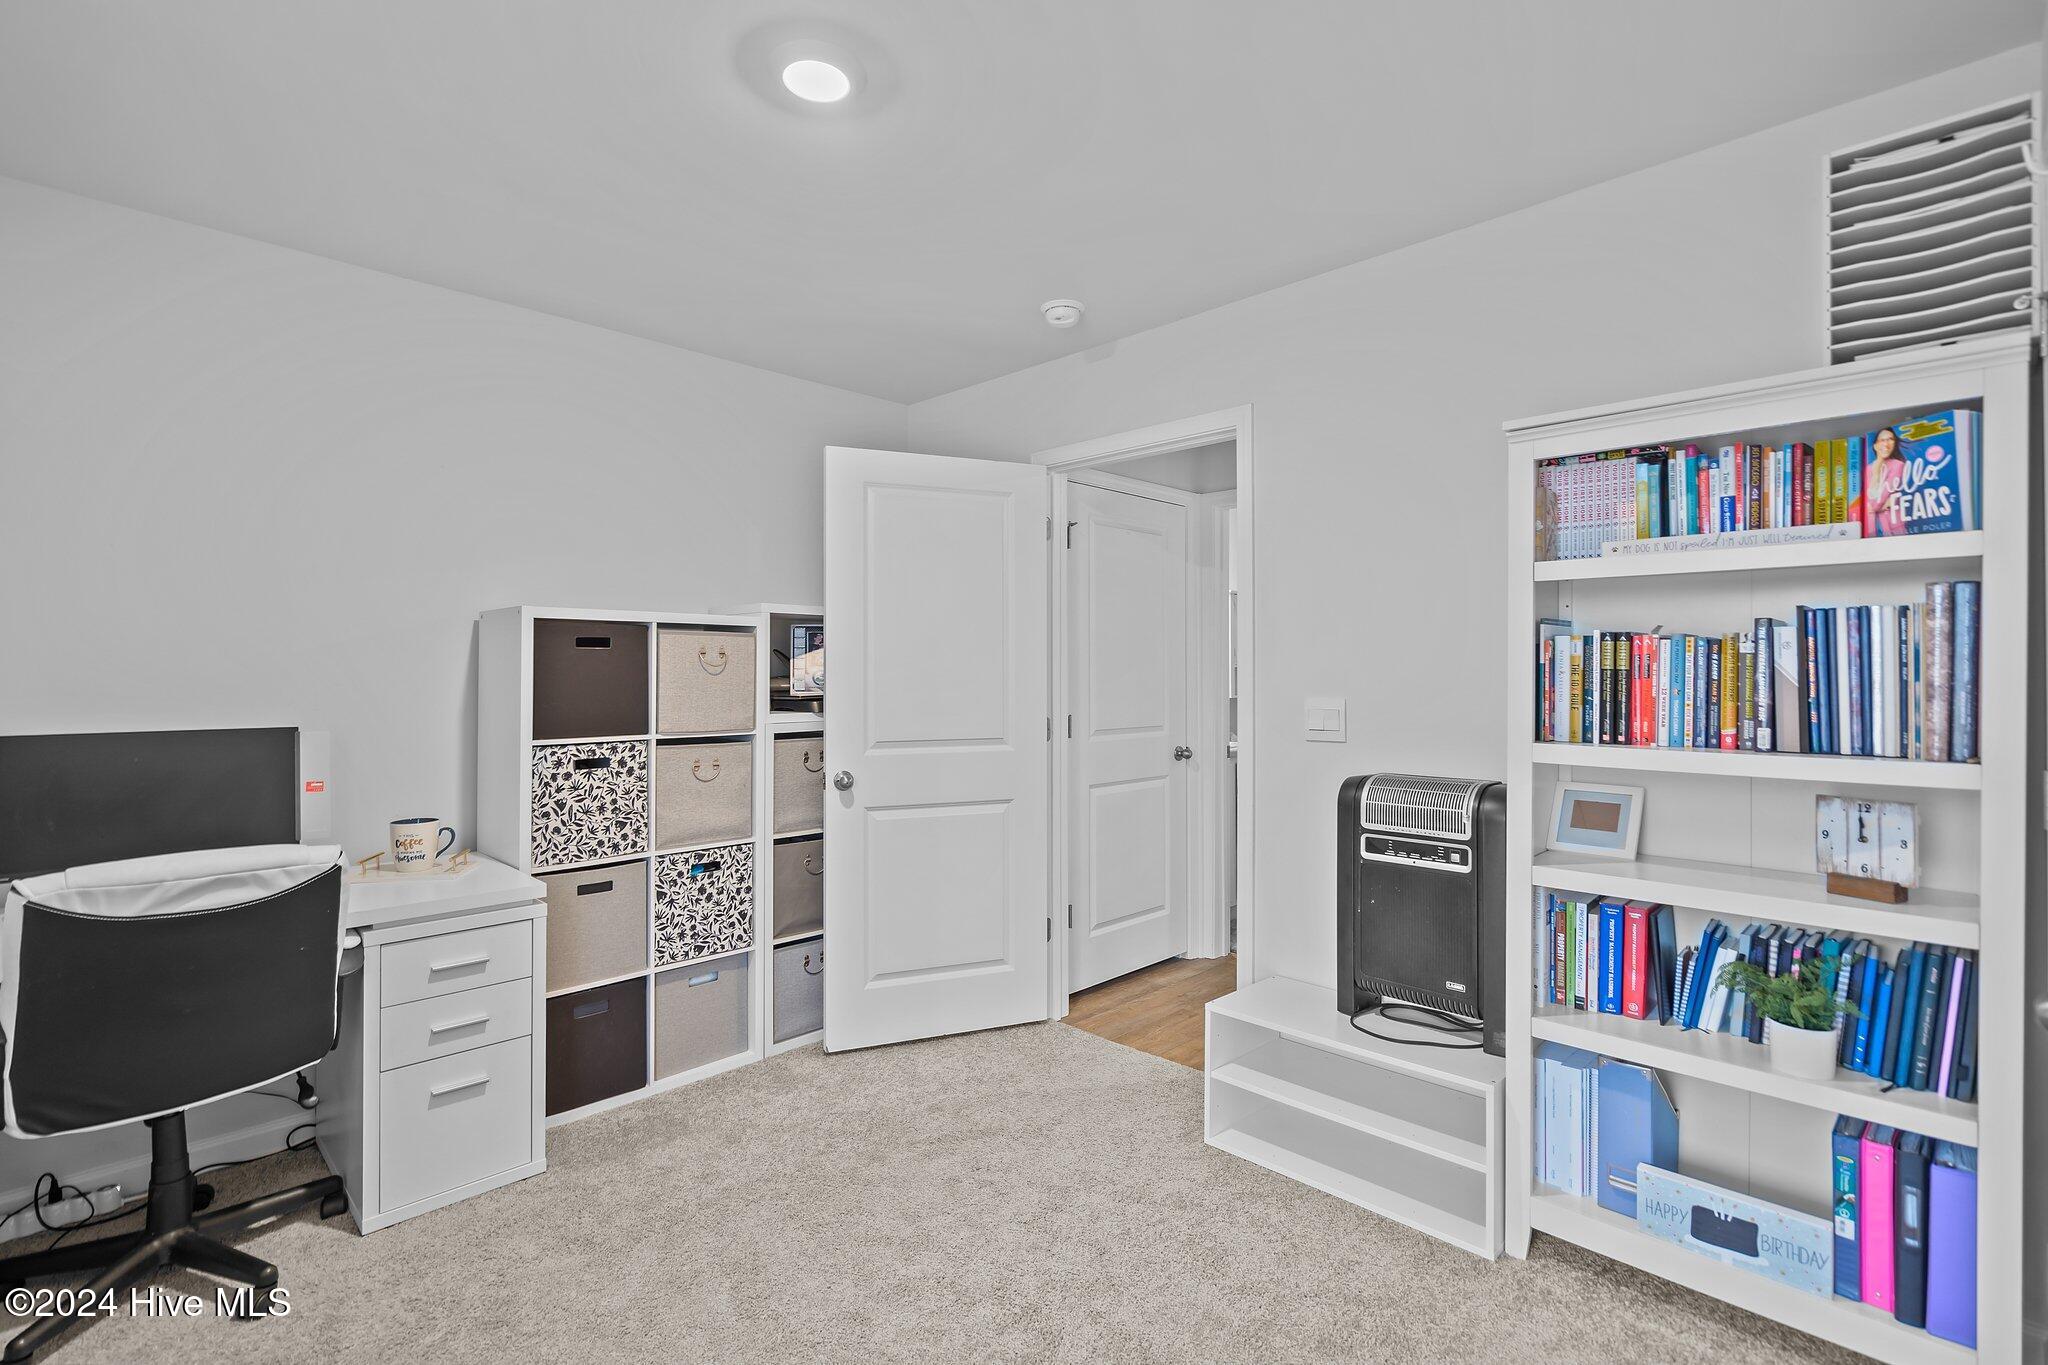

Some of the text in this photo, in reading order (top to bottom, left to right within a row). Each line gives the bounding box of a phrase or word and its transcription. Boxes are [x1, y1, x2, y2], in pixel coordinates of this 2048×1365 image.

[1752, 459, 1760, 486] SINCERO
[1877, 454, 1952, 503] hello
[1889, 486, 1952, 524] FEARS
[1752, 502, 1760, 526] BADASS
[1922, 522, 1952, 531] POLER
[1623, 545, 1632, 553] MY
[1636, 544, 1650, 553] DOG
[1654, 543, 1659, 551] IS
[1664, 542, 1677, 551] NOT
[1740, 535, 1757, 546] JUST
[1763, 534, 1780, 544] WELL
[1572, 664, 1580, 676] THE
[1858, 803, 1872, 813] 12
[1822, 830, 1830, 839] 9
[396, 839, 424, 850] Coffee
[1900, 840, 1908, 850] 3
[1861, 864, 1869, 873] 6
[1646, 1198, 1689, 1224] HAPPY
[1760, 1234, 1830, 1270] BIRTHDAY
